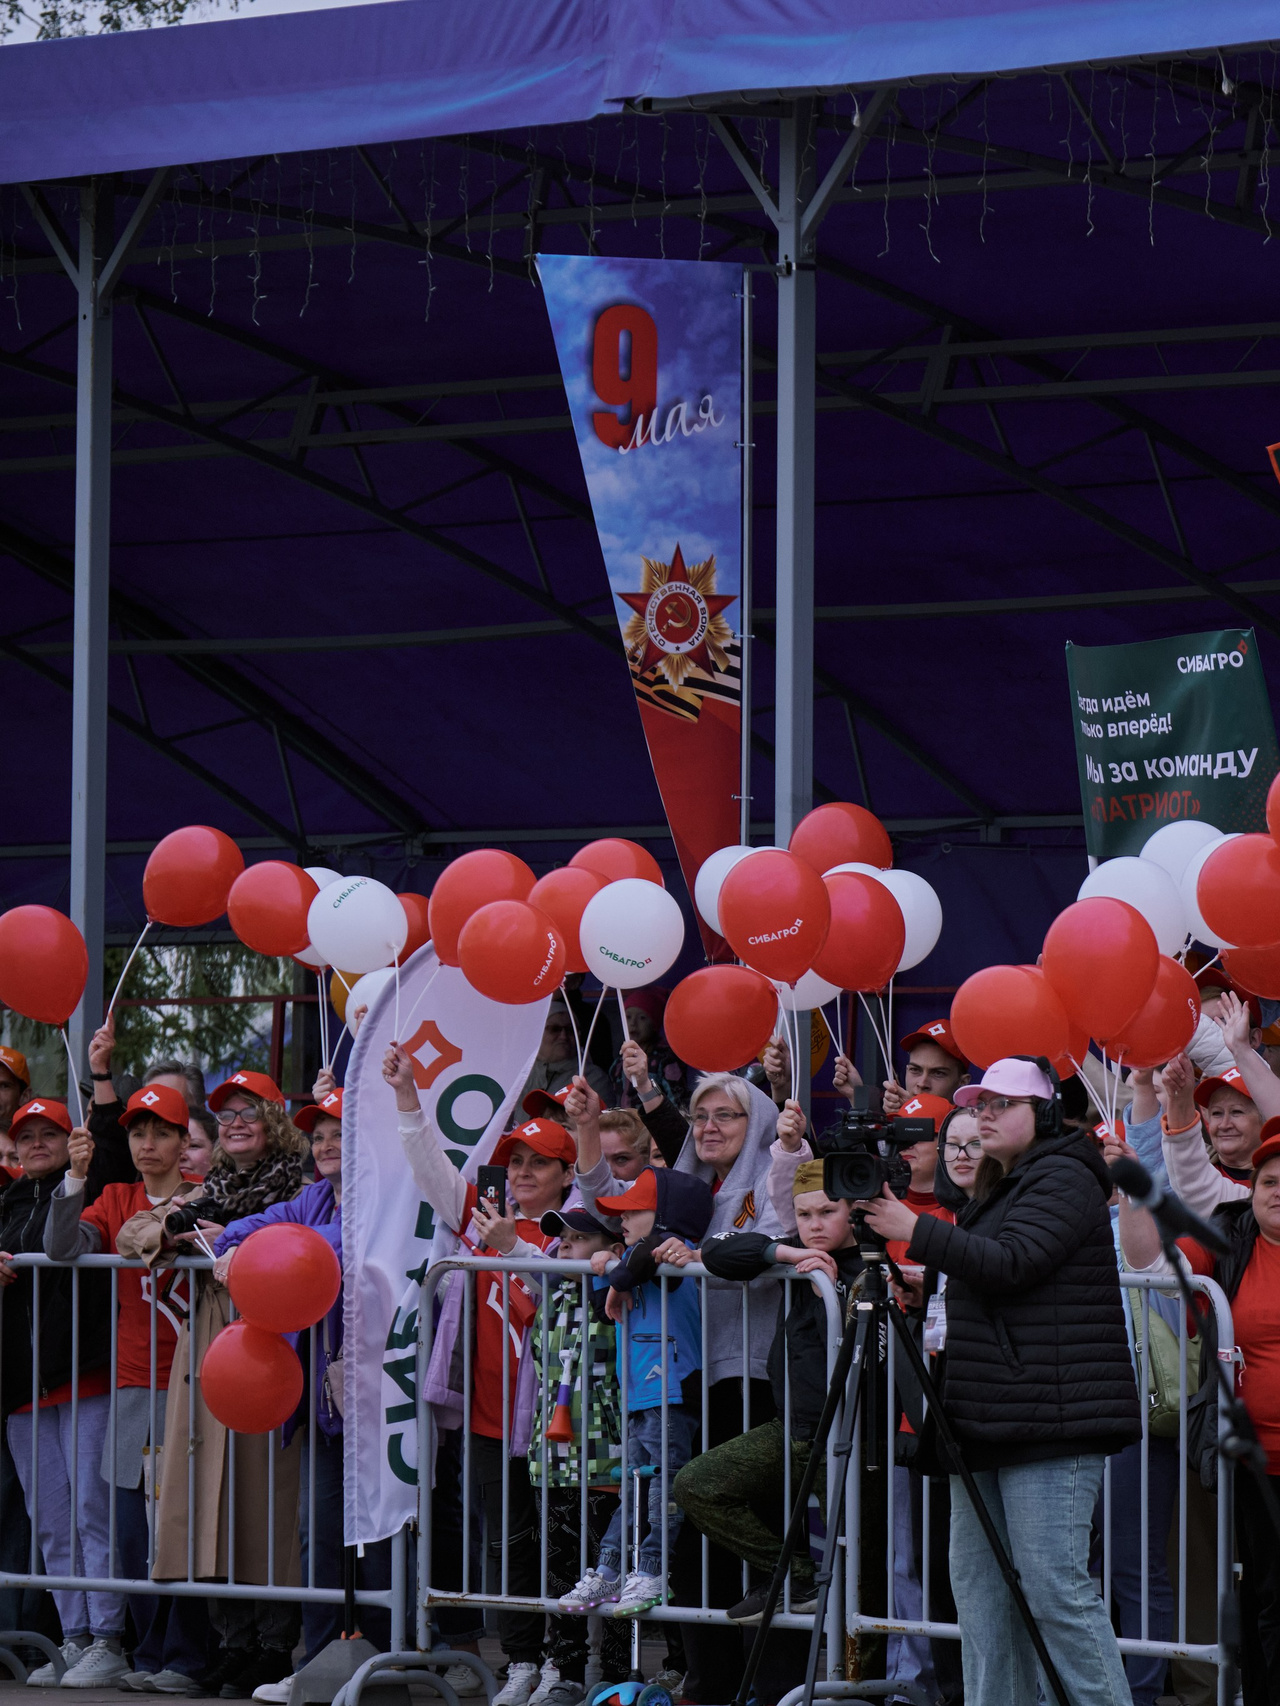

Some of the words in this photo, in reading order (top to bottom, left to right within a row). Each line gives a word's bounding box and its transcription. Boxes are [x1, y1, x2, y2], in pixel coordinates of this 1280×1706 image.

[592, 304, 658, 450] 9
[648, 583, 703, 647] ОТЕЧЕСТВЕННАЯ
[1177, 650, 1244, 674] СИБАГРО
[1101, 690, 1150, 714] идём
[1107, 713, 1173, 739] вперёд!
[1085, 754, 1105, 784] Мы
[1108, 761, 1139, 784] за
[1144, 747, 1259, 780] команду
[333, 881, 367, 908] СИБАГРО
[748, 926, 799, 945] СИБАГРО
[533, 939, 557, 986] СИБАГРО
[599, 946, 645, 969] СИБАГРО
